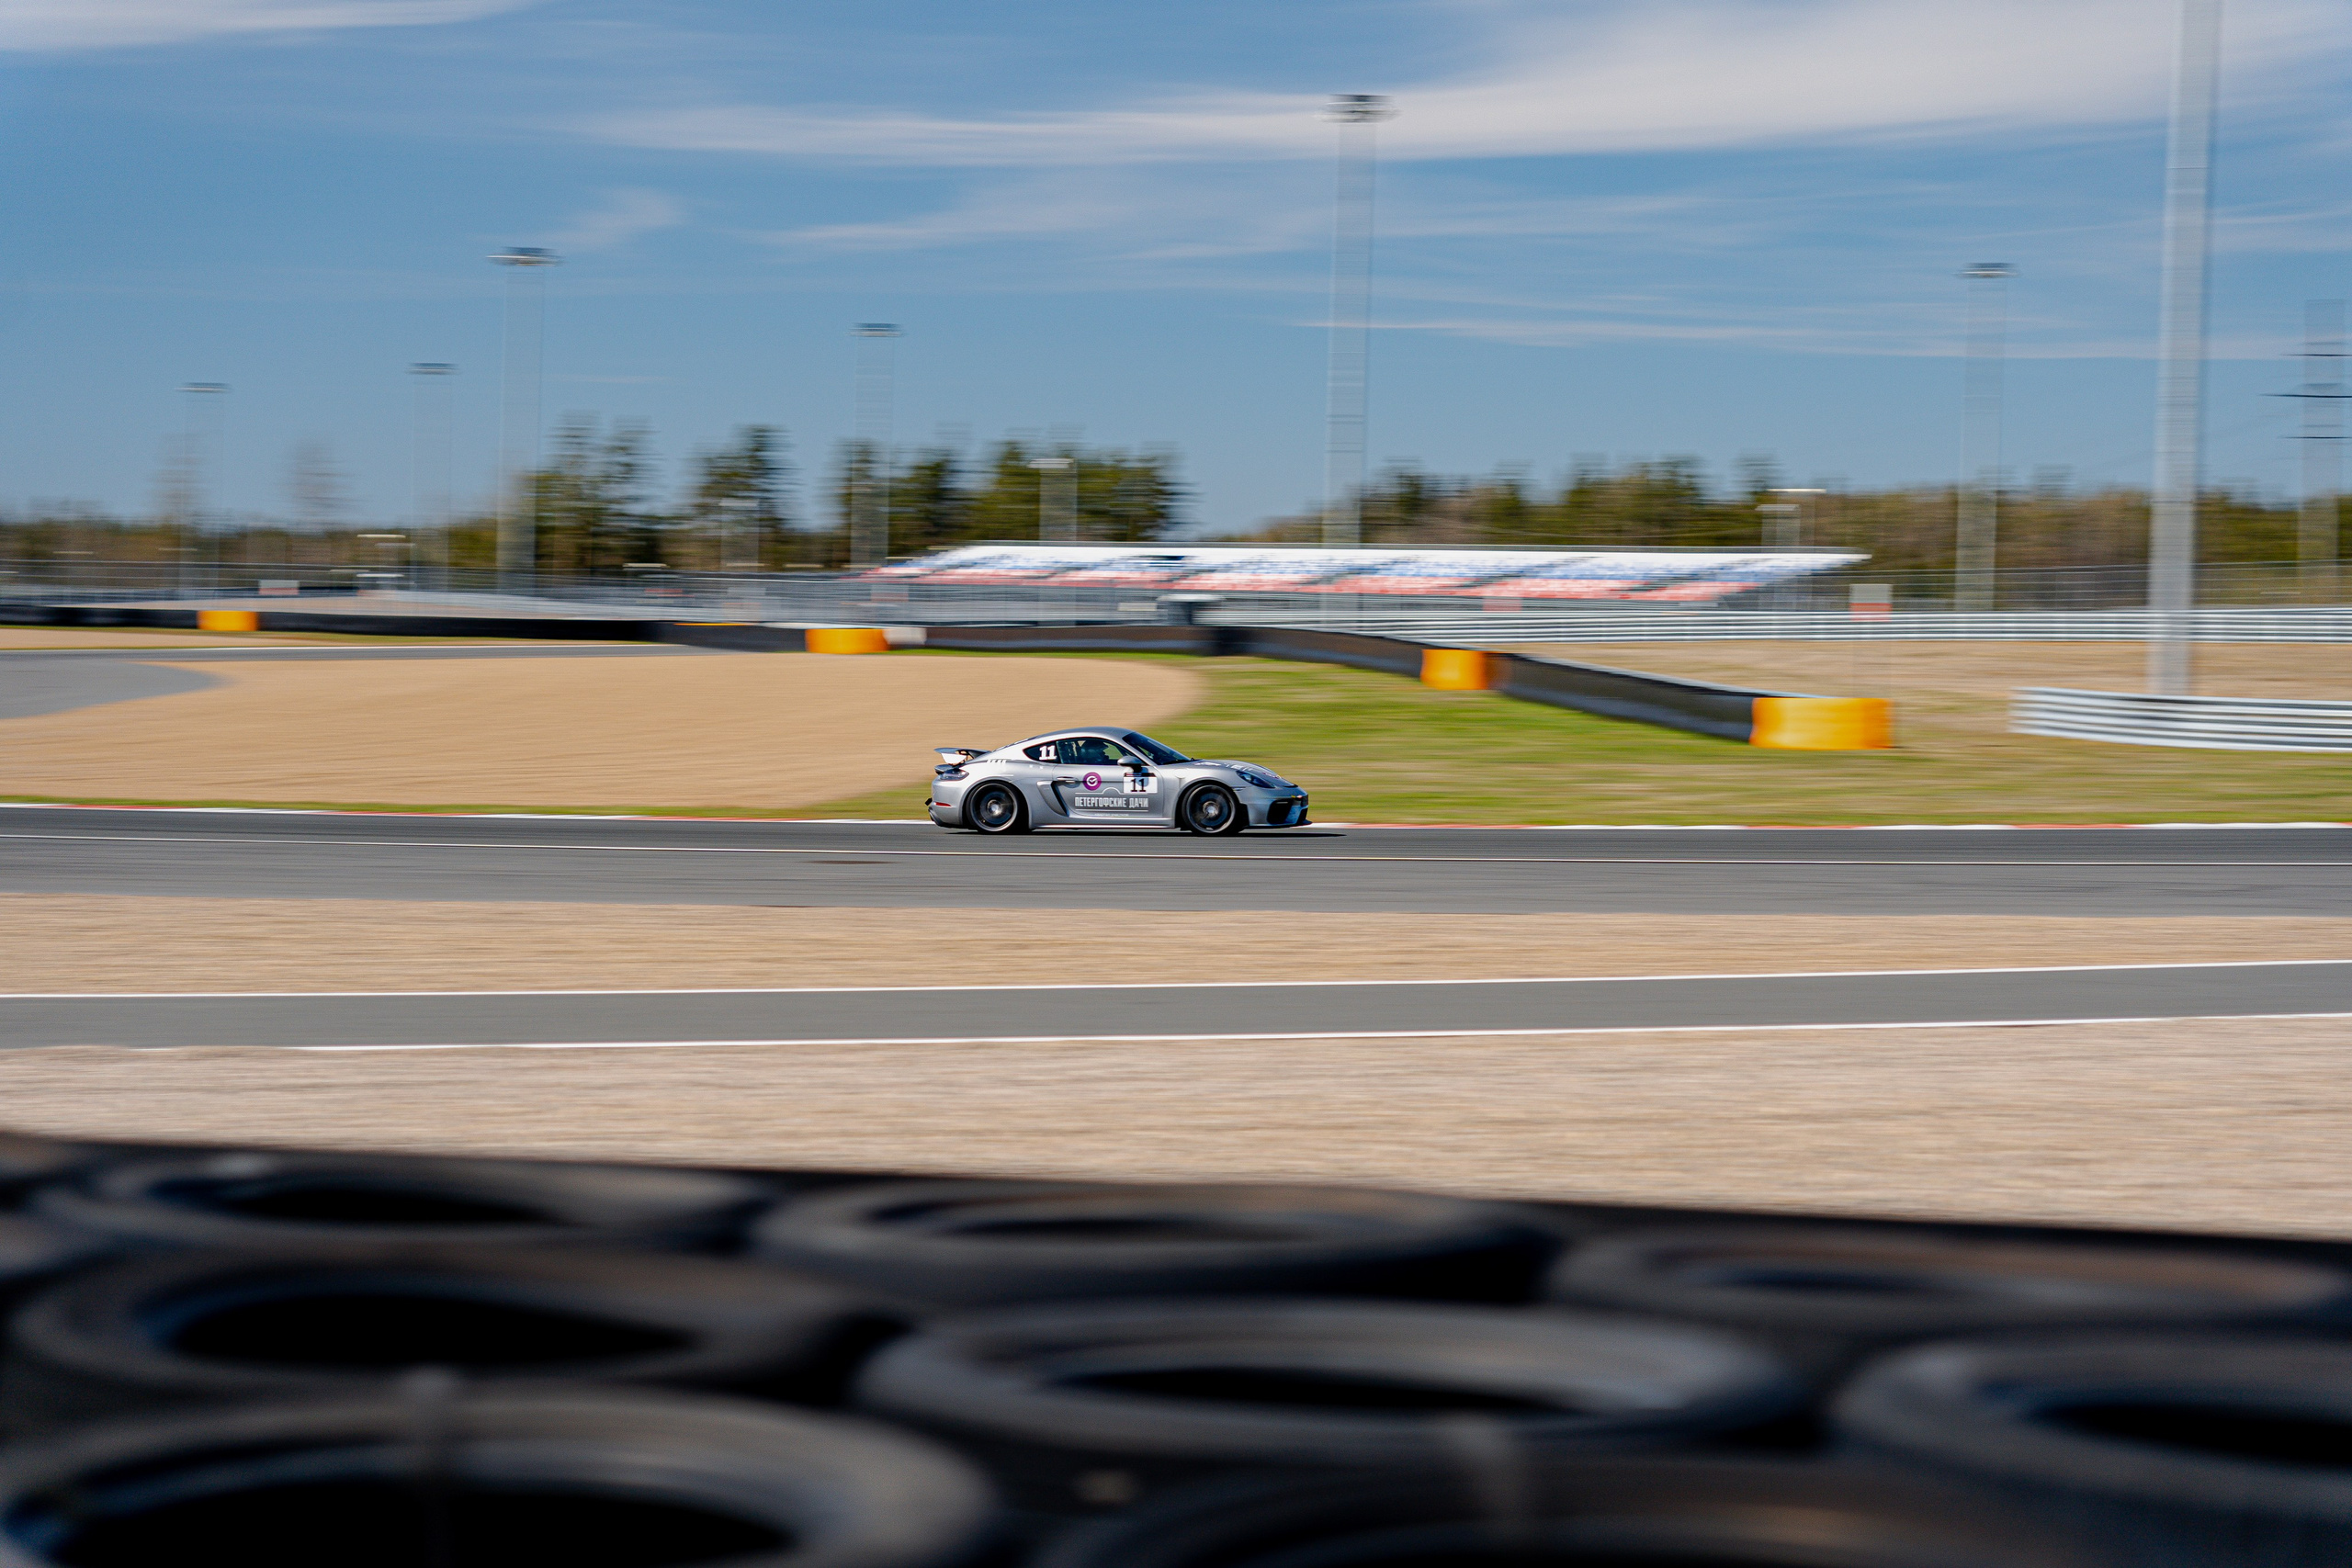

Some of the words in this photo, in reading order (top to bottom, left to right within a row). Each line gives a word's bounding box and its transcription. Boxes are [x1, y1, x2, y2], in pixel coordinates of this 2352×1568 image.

[1039, 745, 1057, 761] 11
[1130, 778, 1147, 792] 11
[1074, 796, 1127, 807] ПЕТЕРГОФСКИЕ
[1129, 797, 1149, 808] ДАЧИ
